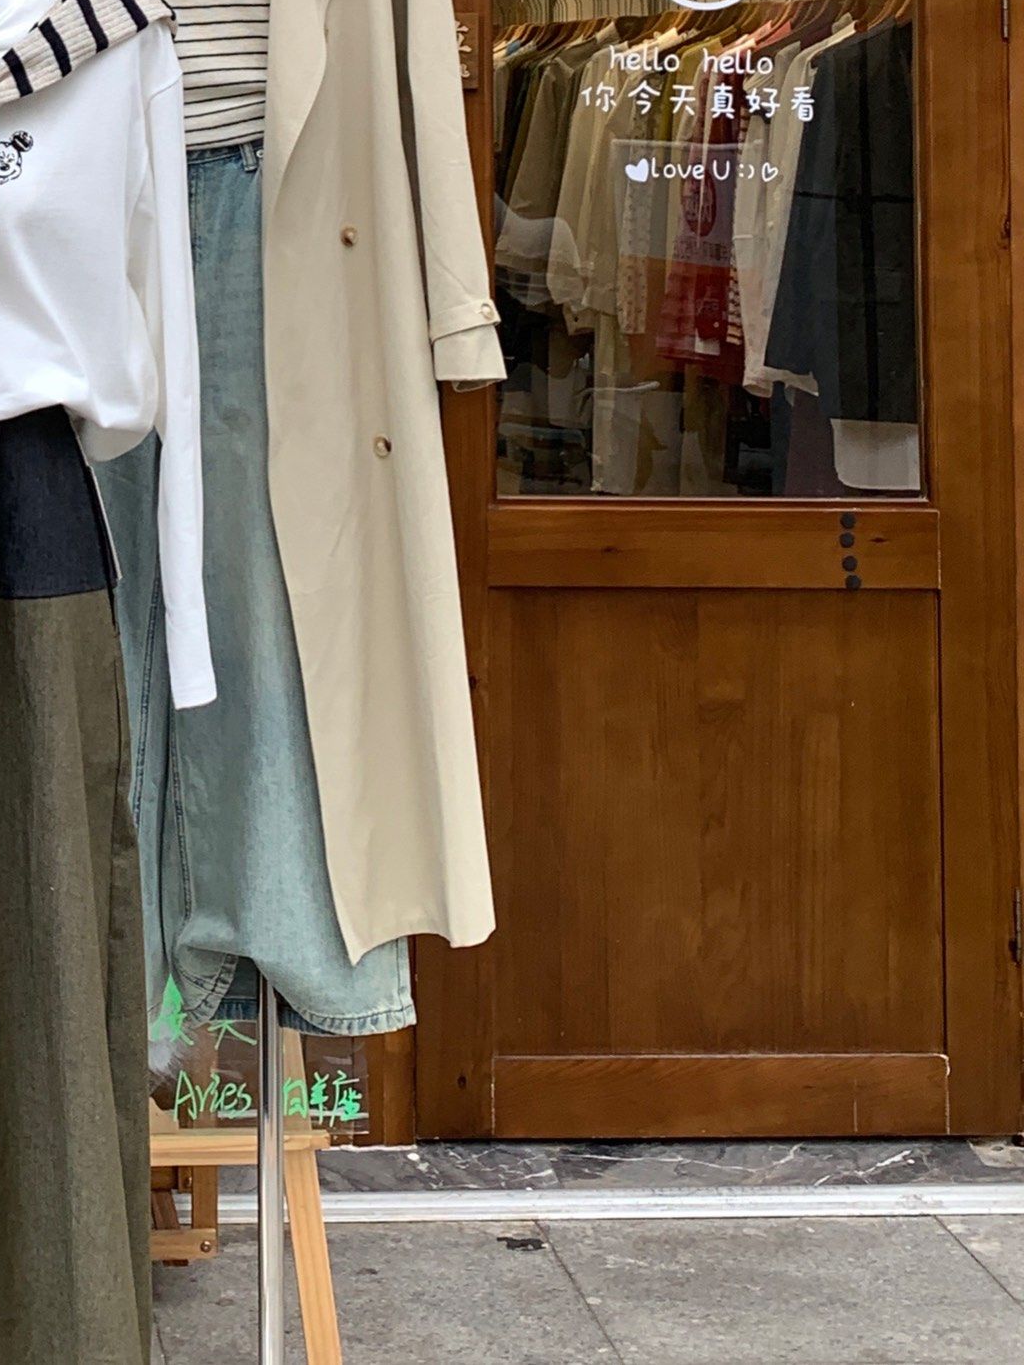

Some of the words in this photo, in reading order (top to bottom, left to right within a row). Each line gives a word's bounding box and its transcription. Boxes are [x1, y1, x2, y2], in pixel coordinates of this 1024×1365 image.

[608, 45, 680, 73] hello
[702, 47, 773, 75] hello
[580, 80, 815, 122] 你今天真好看
[173, 1070, 252, 1122] Aries
